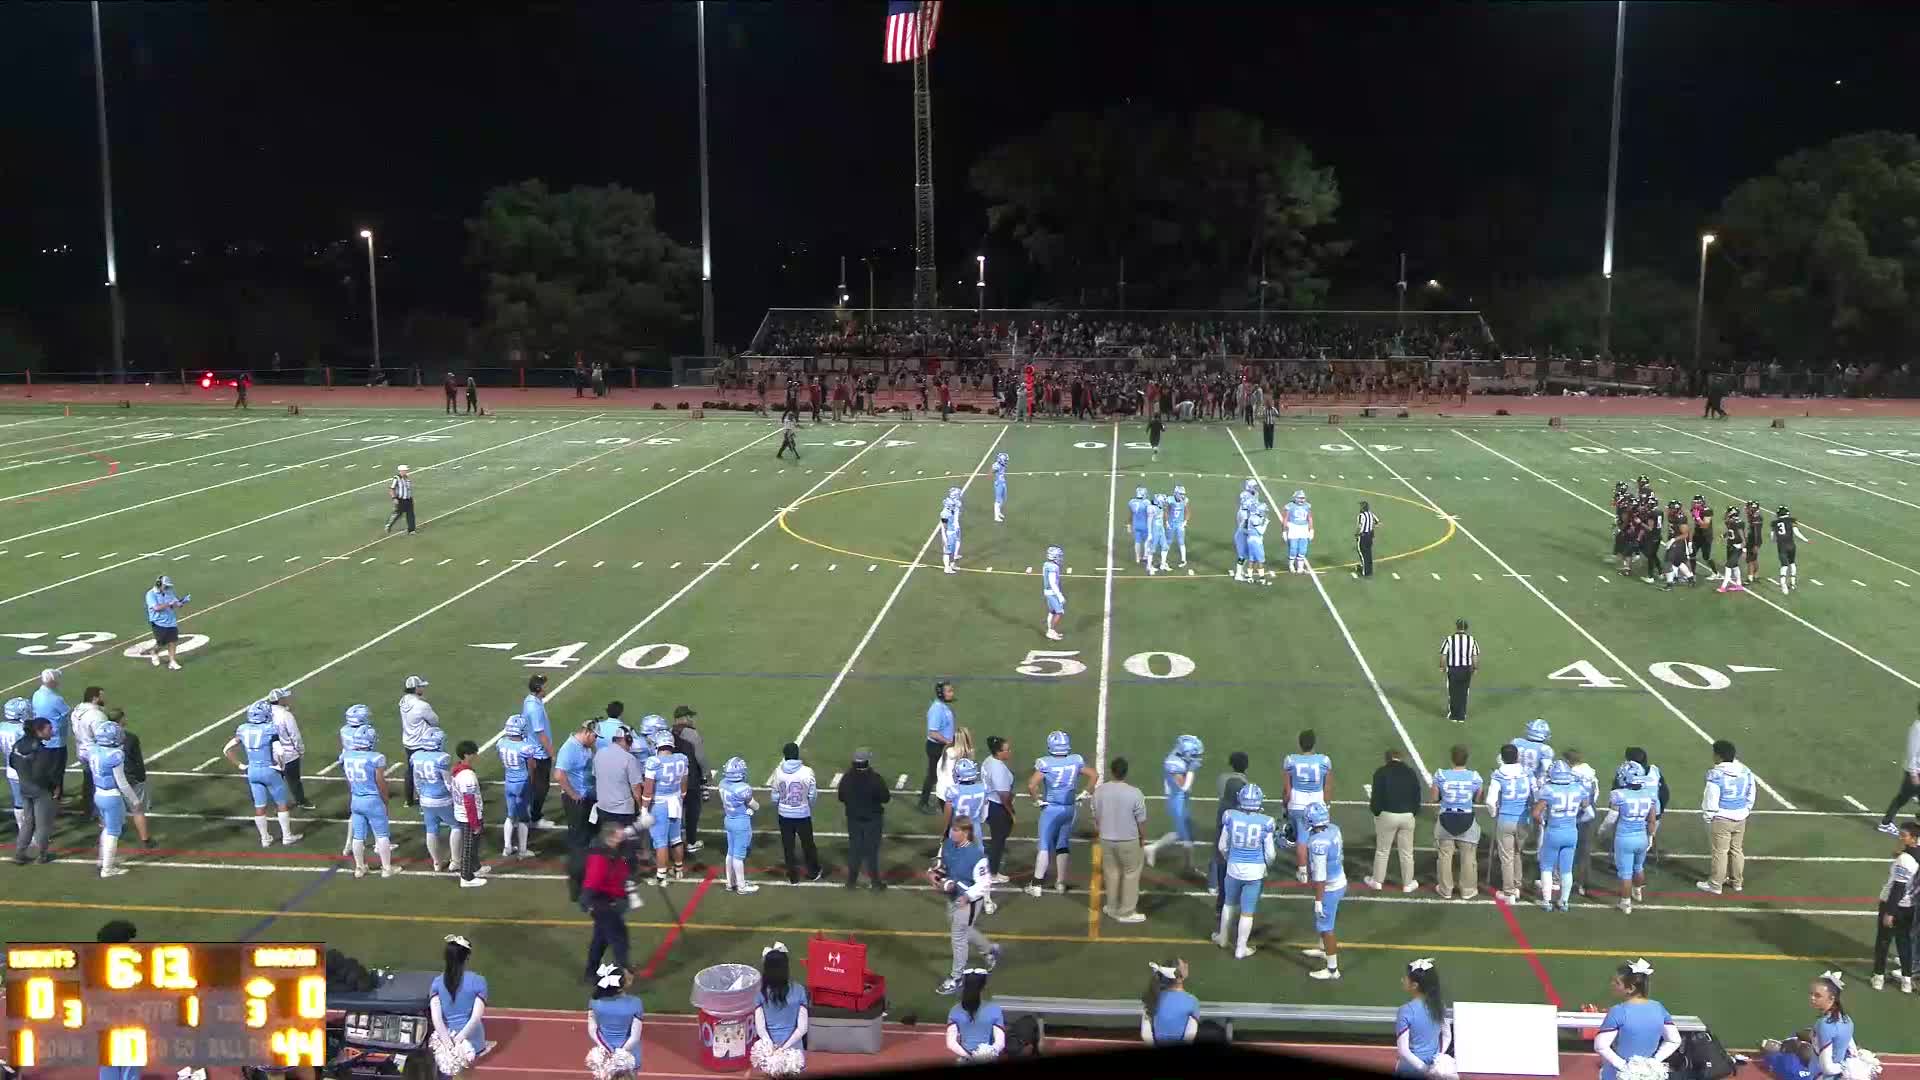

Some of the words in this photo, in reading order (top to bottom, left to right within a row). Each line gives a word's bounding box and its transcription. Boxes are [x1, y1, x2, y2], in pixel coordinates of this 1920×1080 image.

[1777, 522, 1786, 535] 3
[511, 642, 690, 669] 40
[1016, 650, 1195, 679] 50
[1547, 660, 1731, 690] 40
[1051, 765, 1075, 788] 77
[1296, 763, 1320, 784] 51
